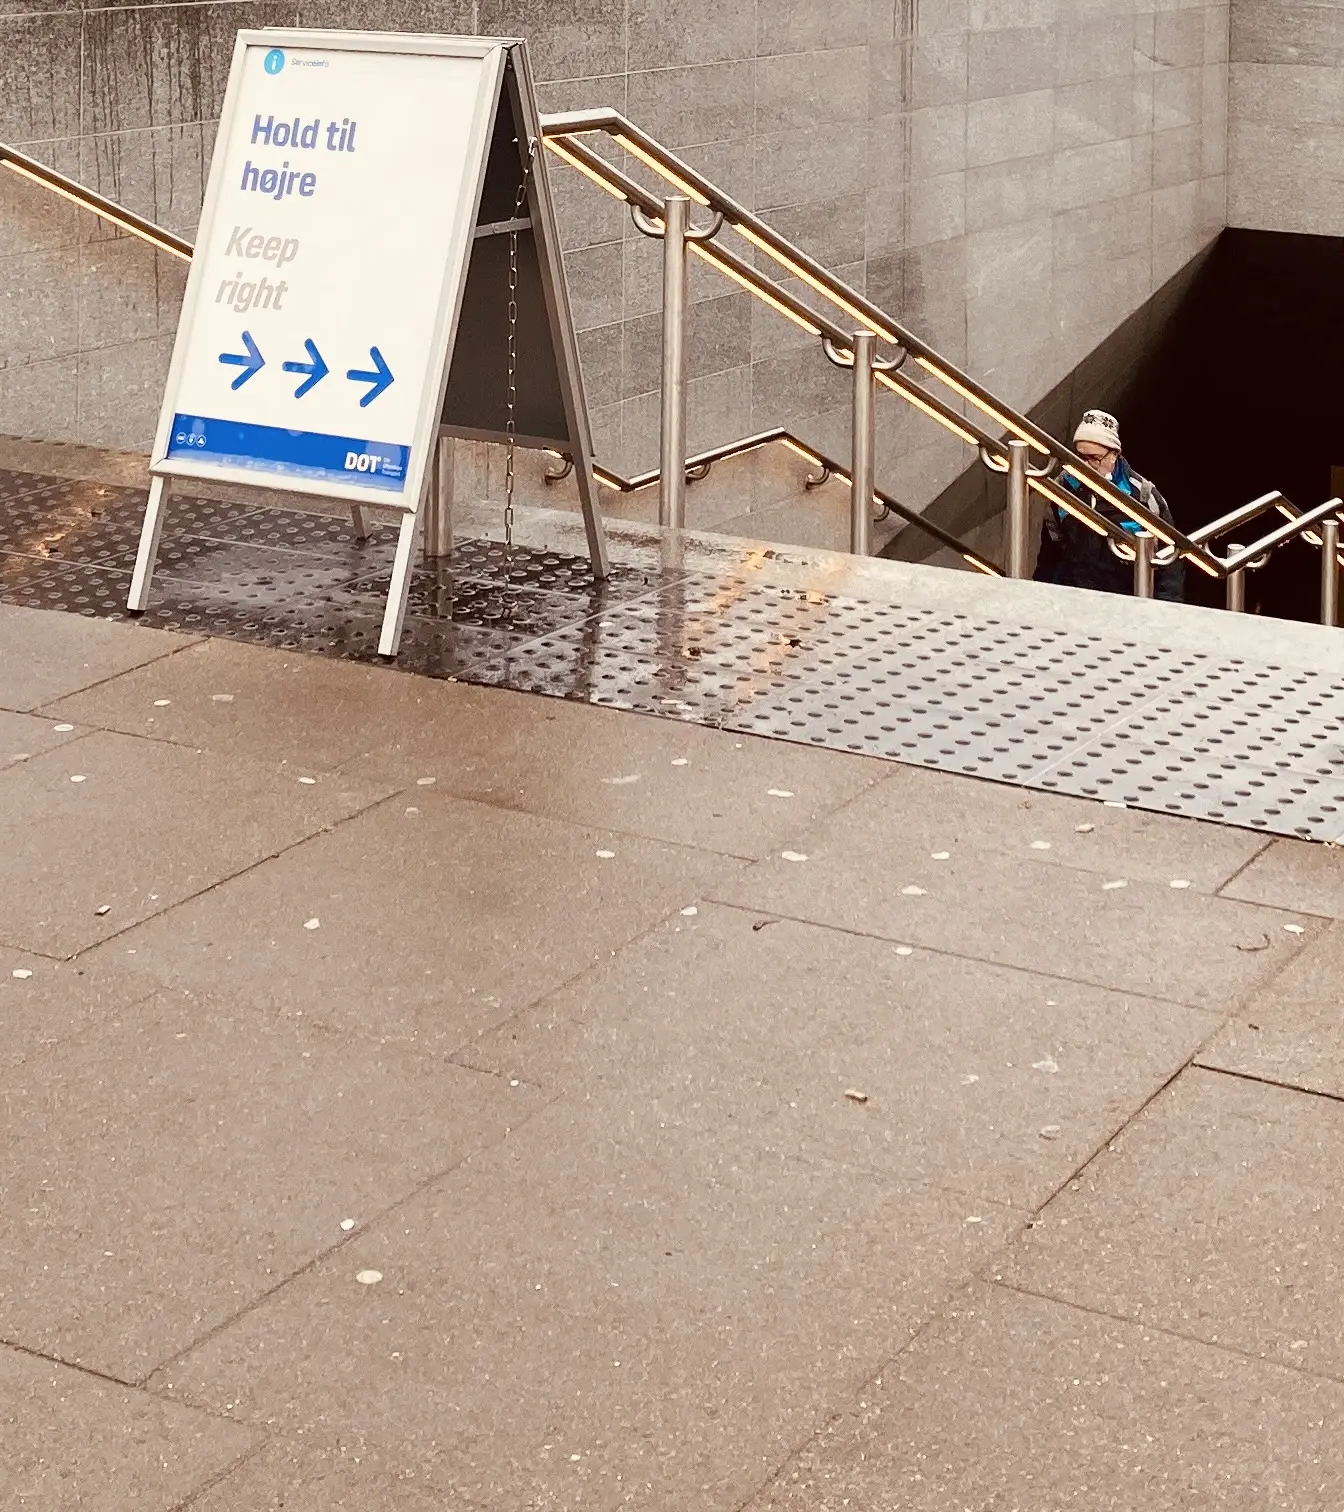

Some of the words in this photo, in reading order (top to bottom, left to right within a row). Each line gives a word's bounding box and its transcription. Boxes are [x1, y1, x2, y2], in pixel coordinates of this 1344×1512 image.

[250, 114, 321, 149] Hold
[326, 118, 357, 153] til
[240, 160, 317, 201] højre
[224, 226, 300, 268] Keep
[215, 271, 289, 313] right
[344, 451, 377, 473] DOT
